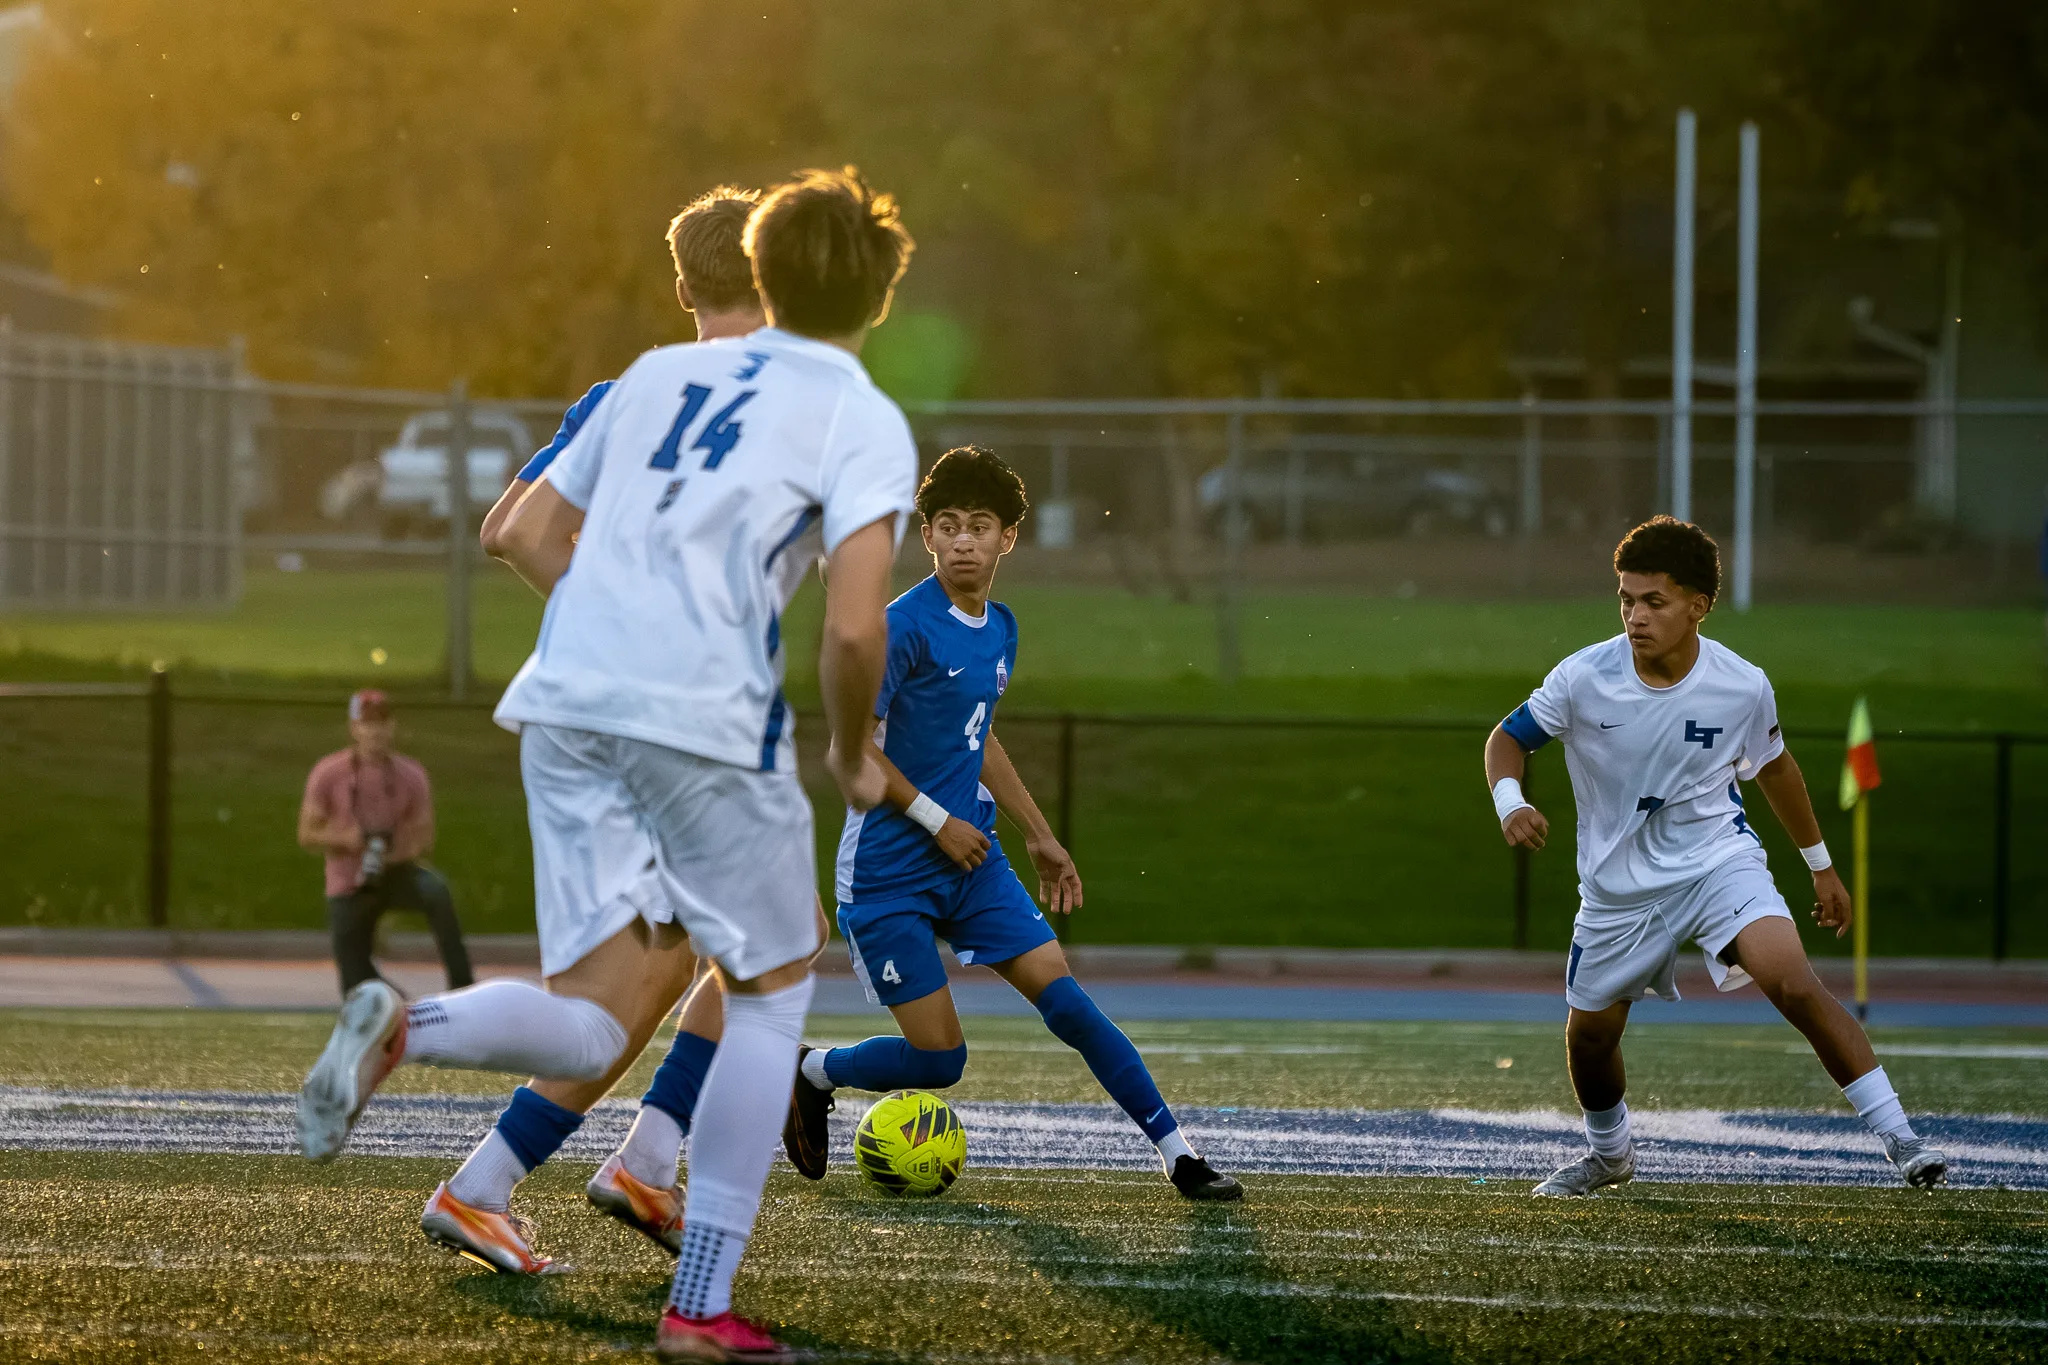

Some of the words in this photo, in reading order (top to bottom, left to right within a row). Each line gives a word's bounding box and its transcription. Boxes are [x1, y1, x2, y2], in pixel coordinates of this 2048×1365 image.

[649, 383, 758, 471] 14
[964, 702, 986, 751] 4
[882, 959, 902, 984] 4
